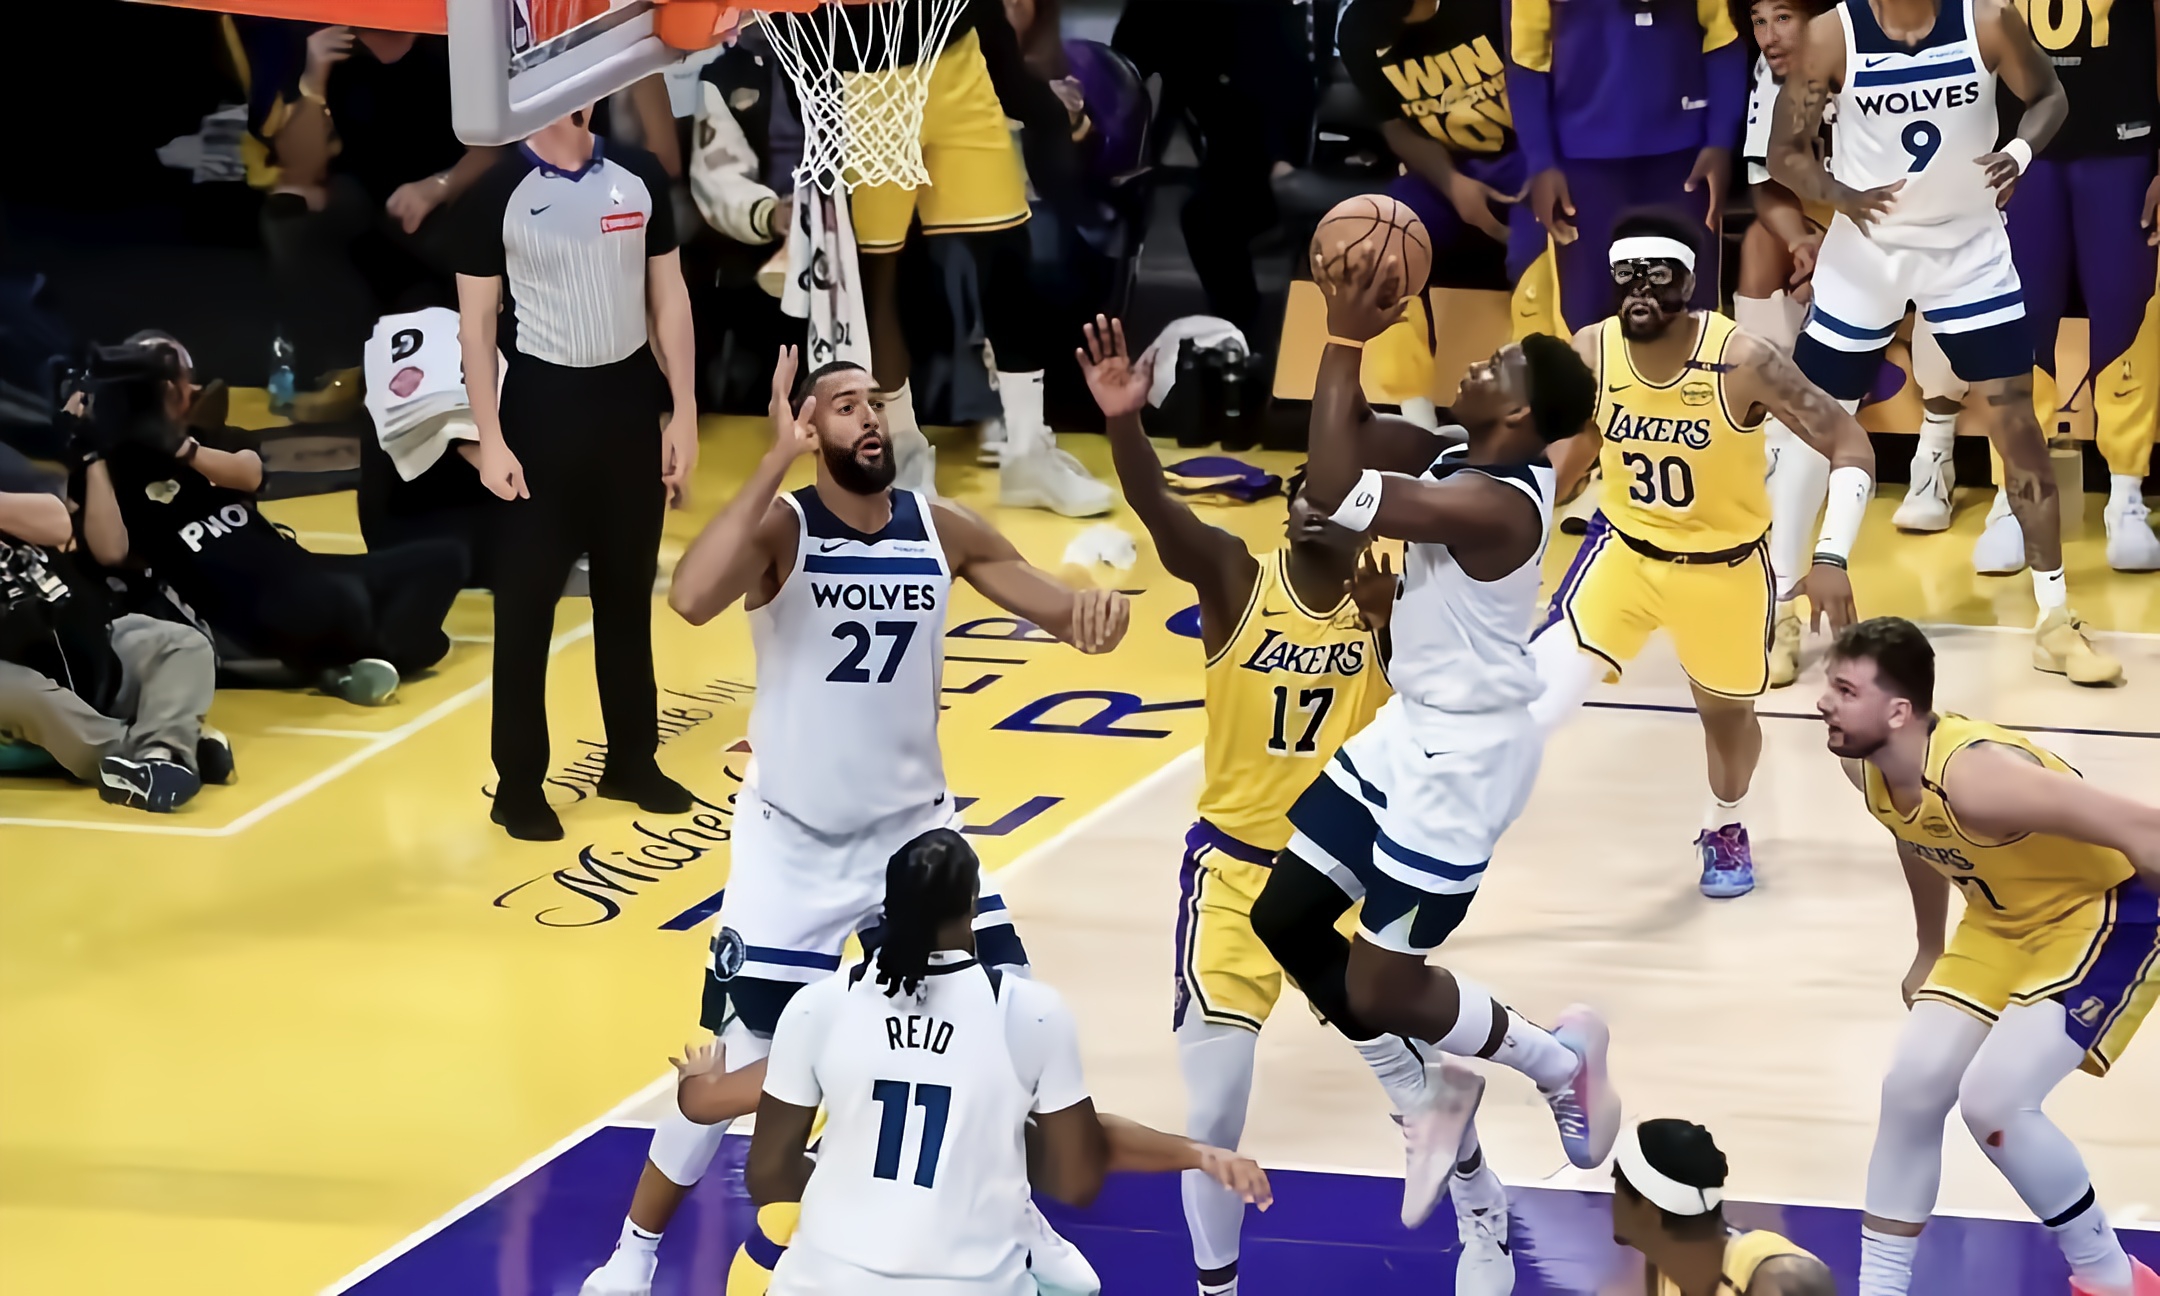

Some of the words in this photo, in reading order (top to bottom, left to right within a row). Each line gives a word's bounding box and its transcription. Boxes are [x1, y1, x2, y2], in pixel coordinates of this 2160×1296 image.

[2013, 0, 2115, 50] OY
[1382, 35, 1504, 100] WIN
[1855, 81, 1979, 116] WOLVES
[1901, 120, 1942, 173] 9
[1604, 402, 1712, 450] LAKERS
[1356, 491, 1374, 509] 5
[1622, 451, 1695, 507] 30
[811, 583, 935, 611] WOLVES
[826, 621, 917, 683] 27
[1240, 629, 1364, 676] LAKERS
[1268, 686, 1334, 752] 17
[493, 765, 744, 927] Michel
[885, 1015, 954, 1055] REID
[872, 1079, 952, 1189] 11
